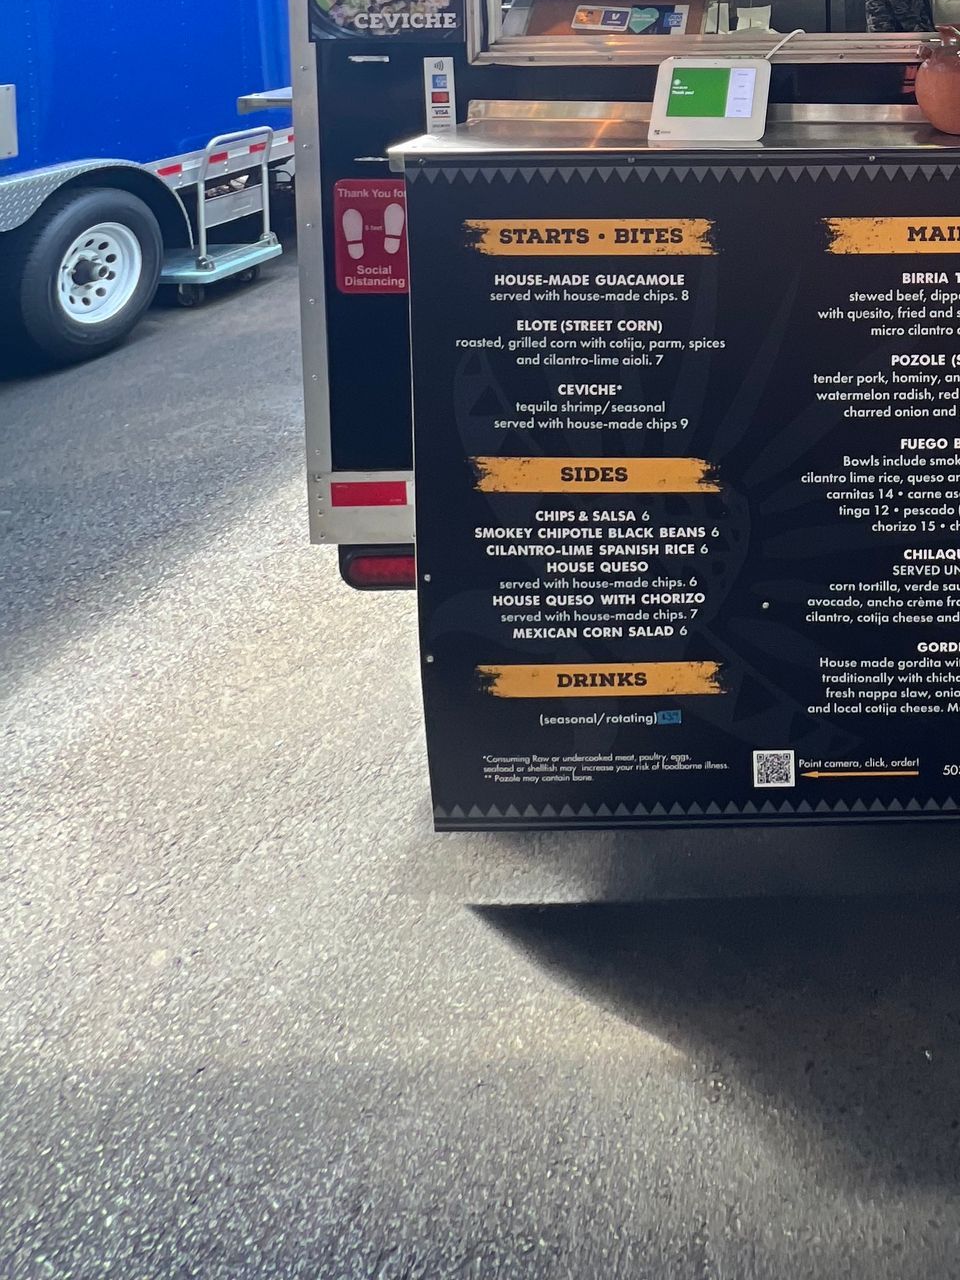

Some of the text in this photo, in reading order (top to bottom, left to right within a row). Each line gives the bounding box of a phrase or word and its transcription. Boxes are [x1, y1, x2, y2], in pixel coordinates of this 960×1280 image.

[354, 12, 457, 29] CEVICHE
[337, 188, 369, 198] Thank
[372, 189, 391, 198] You
[500, 228, 684, 244] STARTS BITES
[357, 265, 392, 275] Social
[345, 276, 405, 288] Distancing
[494, 274, 684, 285] HOUSE-MADE GUACAMOLE
[902, 272, 948, 283] BIRRIA
[490, 289, 689, 304] served with house-made chips. 8
[849, 289, 892, 301] stewed
[896, 289, 926, 302] beef,
[516, 320, 662, 333] ELOTE (STREET CORN)
[456, 335, 725, 351] roasted, grilled corn with cotija, parm, spices
[891, 354, 945, 366] POZOLE
[900, 438, 948, 449] FUEGO
[843, 454, 880, 466] Bowls
[882, 454, 926, 466] include
[560, 467, 628, 482] SIDES
[535, 510, 650, 521] CHIPS & SALSA 6
[546, 561, 648, 573] HOUSE QUESO
[892, 565, 940, 575] SERVED
[512, 625, 687, 638] MEXICAN CORN SALAD 6
[557, 672, 648, 688] DRINKS
[822, 672, 894, 685] traditionally
[897, 672, 922, 682] with
[798, 758, 821, 768] Point
[890, 756, 919, 766] order!
